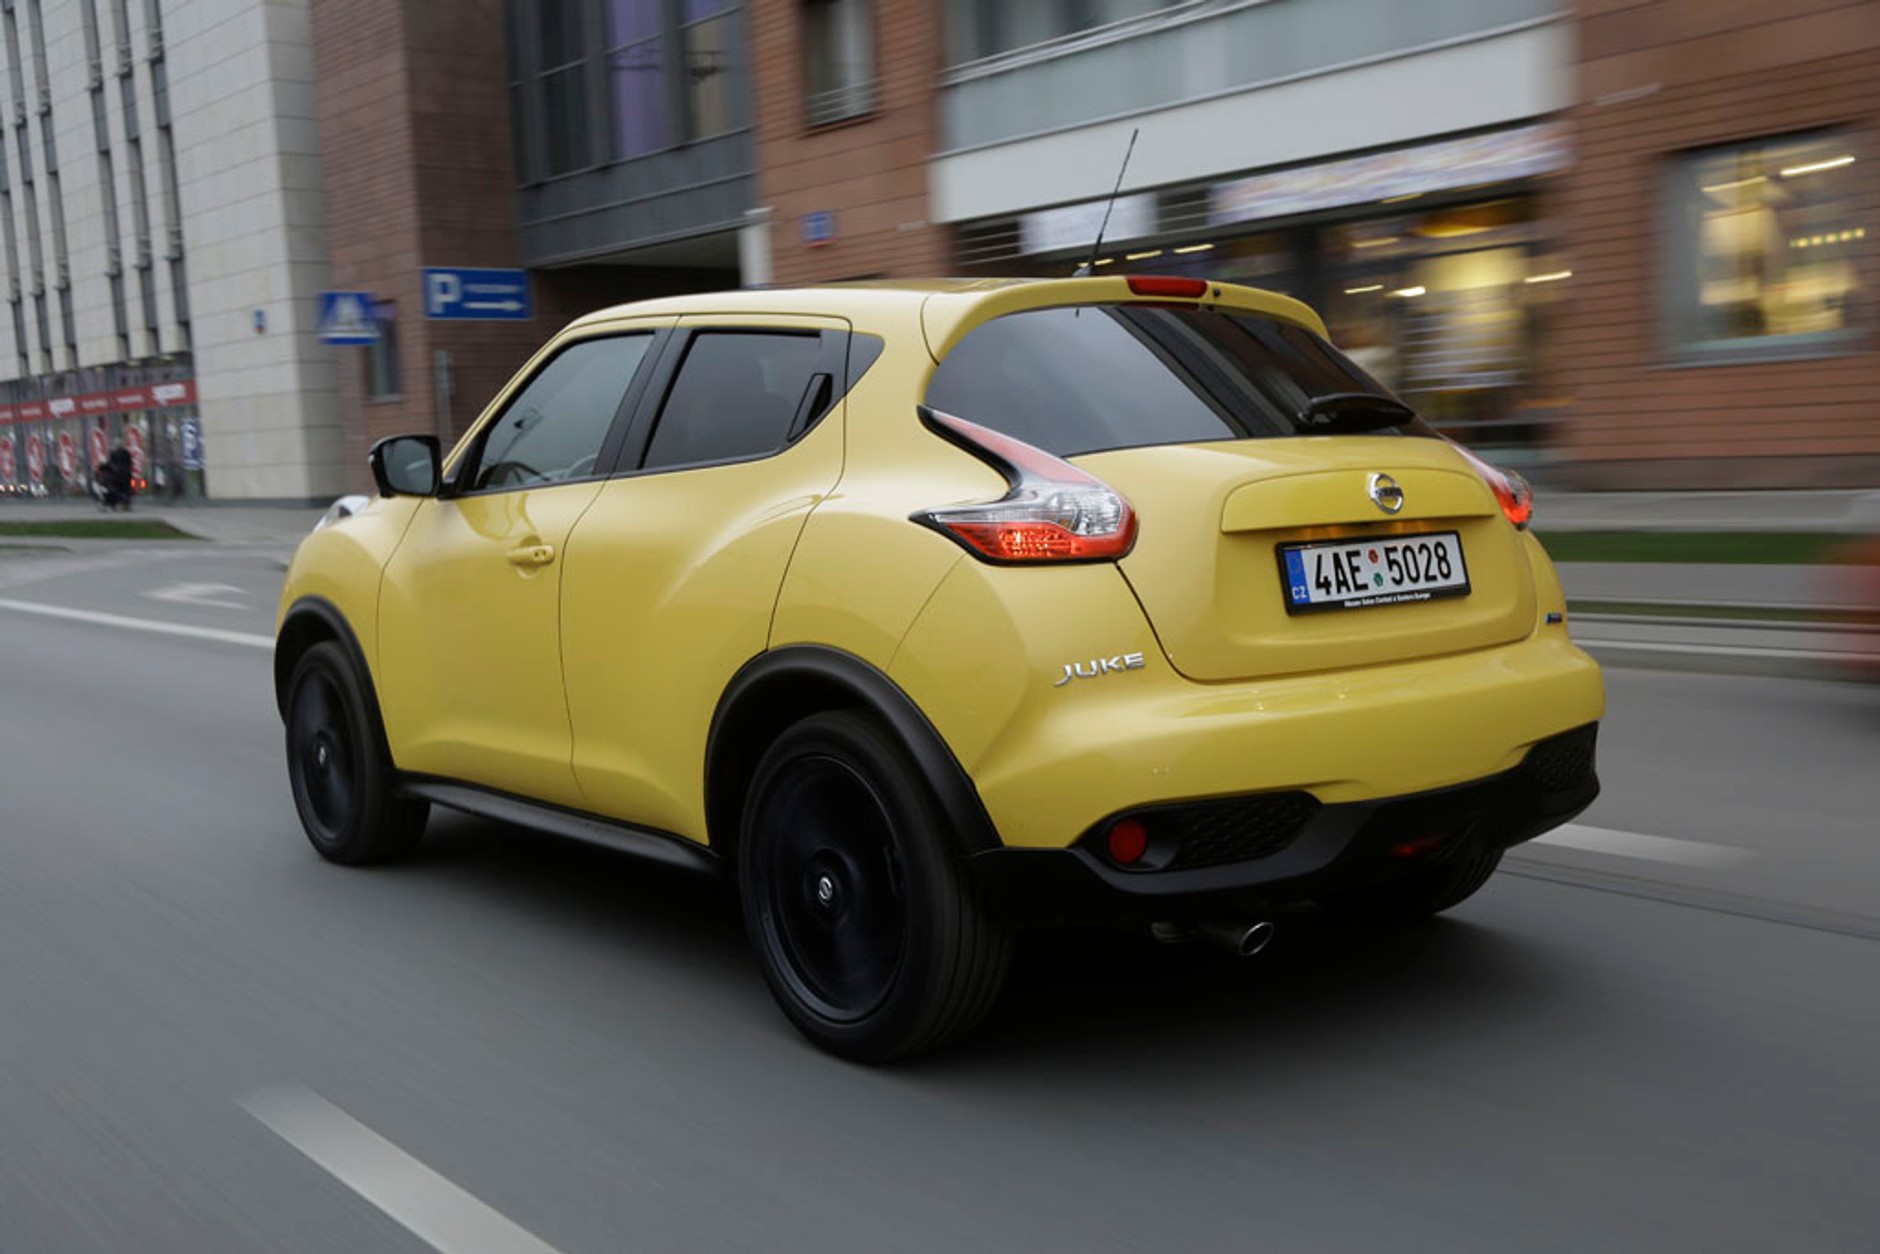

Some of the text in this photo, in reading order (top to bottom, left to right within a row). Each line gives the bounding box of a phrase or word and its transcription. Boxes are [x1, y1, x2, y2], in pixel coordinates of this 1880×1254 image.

[429, 273, 462, 314] P
[1315, 541, 1452, 595] 4AE 5028
[1292, 586, 1308, 599] CZ
[1054, 651, 1144, 688] JUKE
